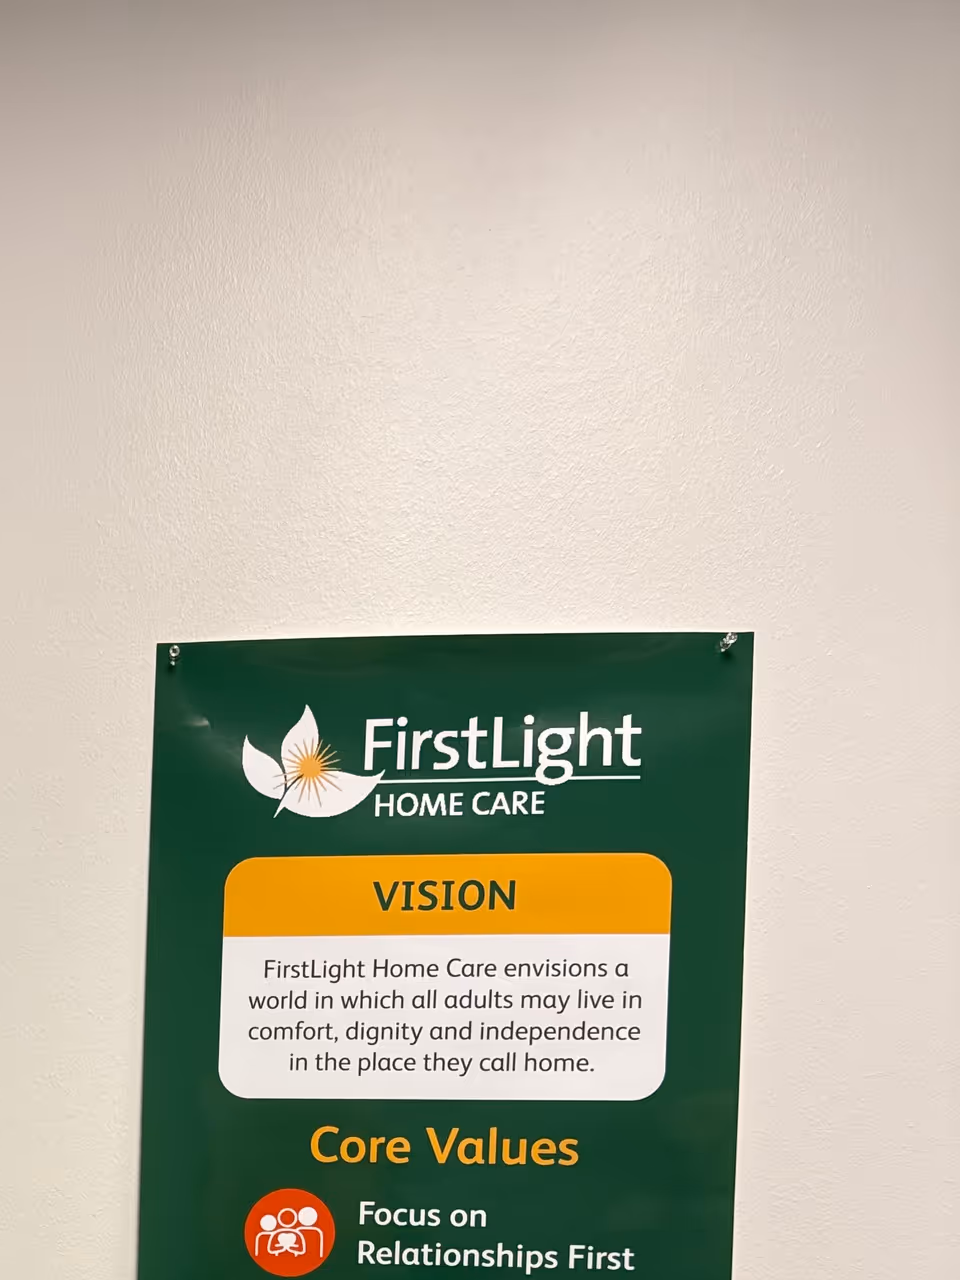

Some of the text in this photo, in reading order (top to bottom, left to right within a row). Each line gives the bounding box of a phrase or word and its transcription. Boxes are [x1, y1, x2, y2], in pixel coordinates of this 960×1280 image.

[364, 711, 642, 786] FirstLight
[374, 790, 544, 817] HOME CARE
[373, 879, 515, 911] VISION
[264, 958, 628, 983] FirstLight Home Care envisions a
[248, 988, 641, 1014] world in which all adults may live in
[248, 1020, 640, 1045] comfort, dignity and independence
[290, 1051, 594, 1076] in the place they call home.
[310, 1125, 578, 1166] Core Values
[359, 1201, 486, 1227] Focus on
[358, 1240, 634, 1273] Relationships First
